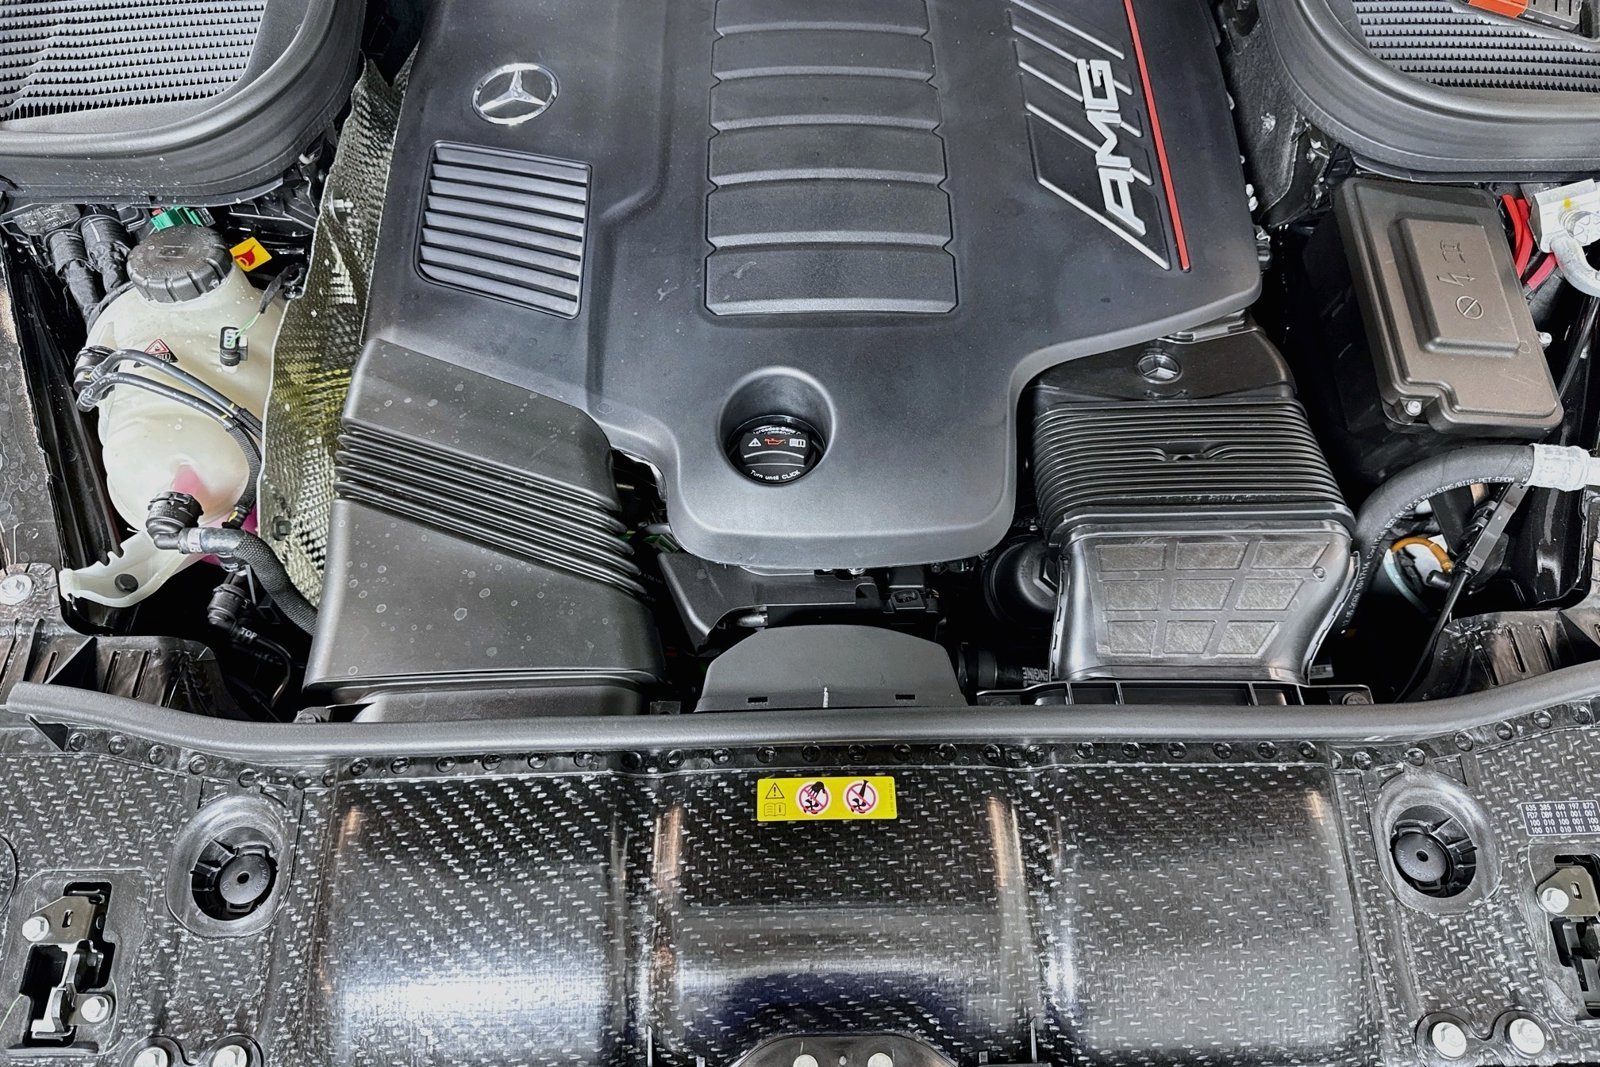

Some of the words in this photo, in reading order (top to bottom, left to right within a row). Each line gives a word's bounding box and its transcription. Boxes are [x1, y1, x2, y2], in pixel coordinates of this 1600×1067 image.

[1077, 58, 1147, 236] AMG
[750, 469, 763, 479] Turn
[782, 470, 801, 480] CLICK
[240, 626, 258, 640] TOP
